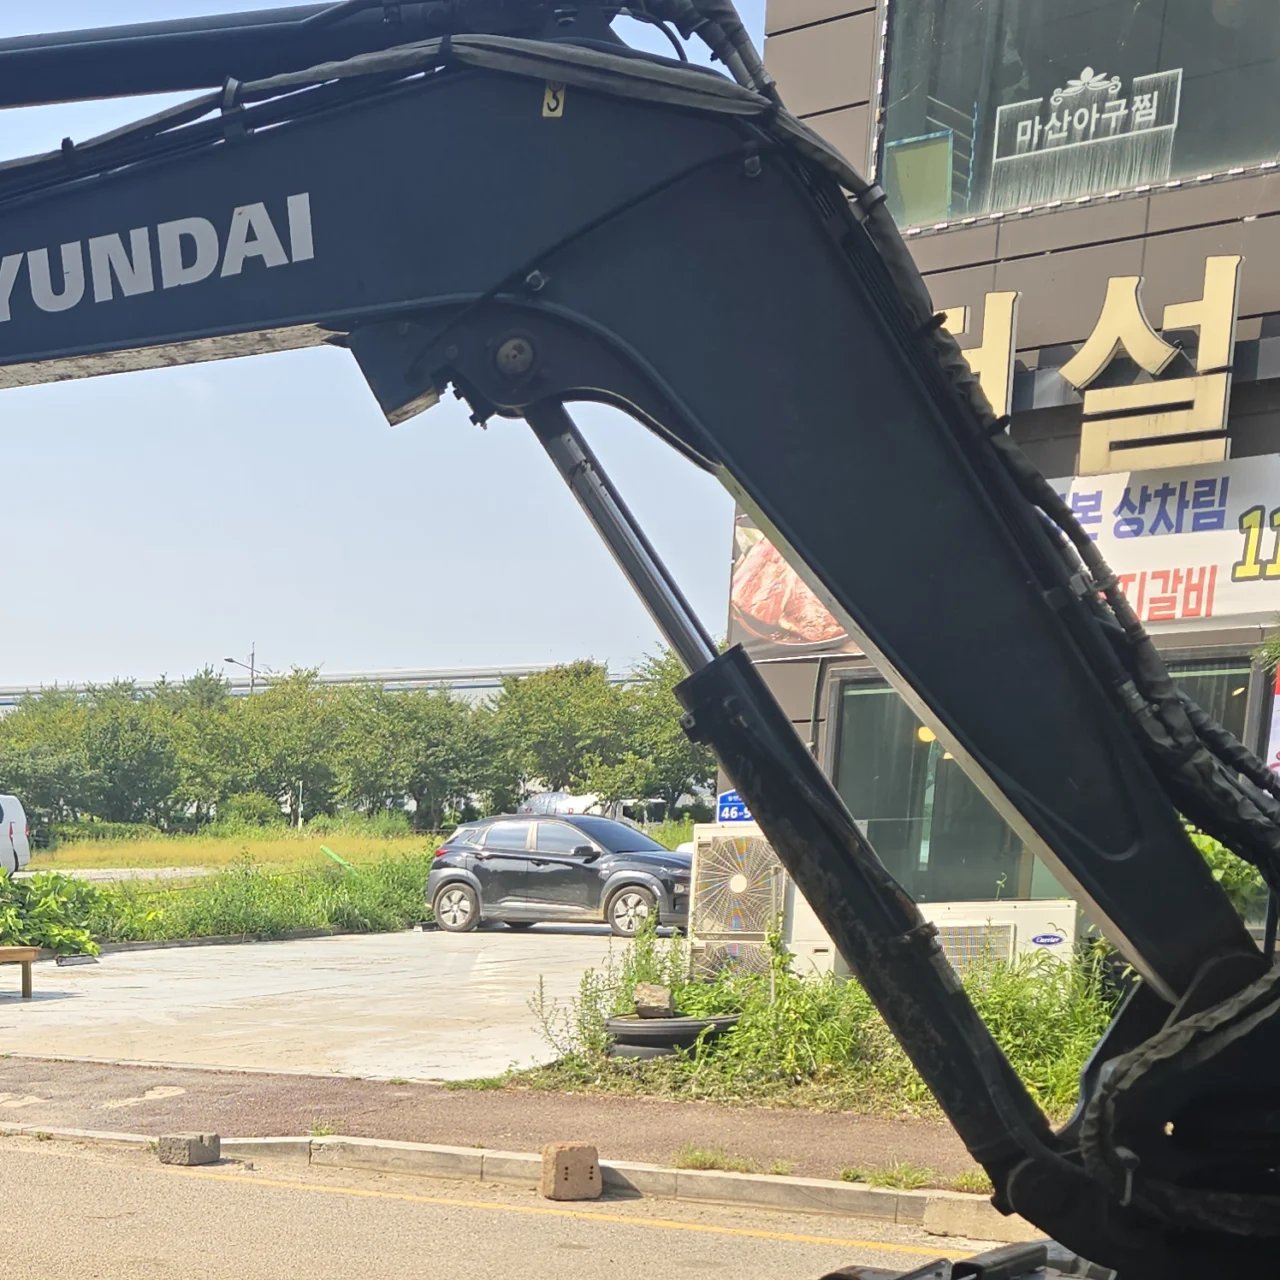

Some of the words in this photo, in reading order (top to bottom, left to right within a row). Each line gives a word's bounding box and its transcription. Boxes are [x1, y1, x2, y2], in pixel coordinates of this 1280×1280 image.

[1016, 90, 1159, 146] 마산아구찜
[1111, 476, 1230, 540] 상차림
[1104, 564, 1219, 622] 지갈비
